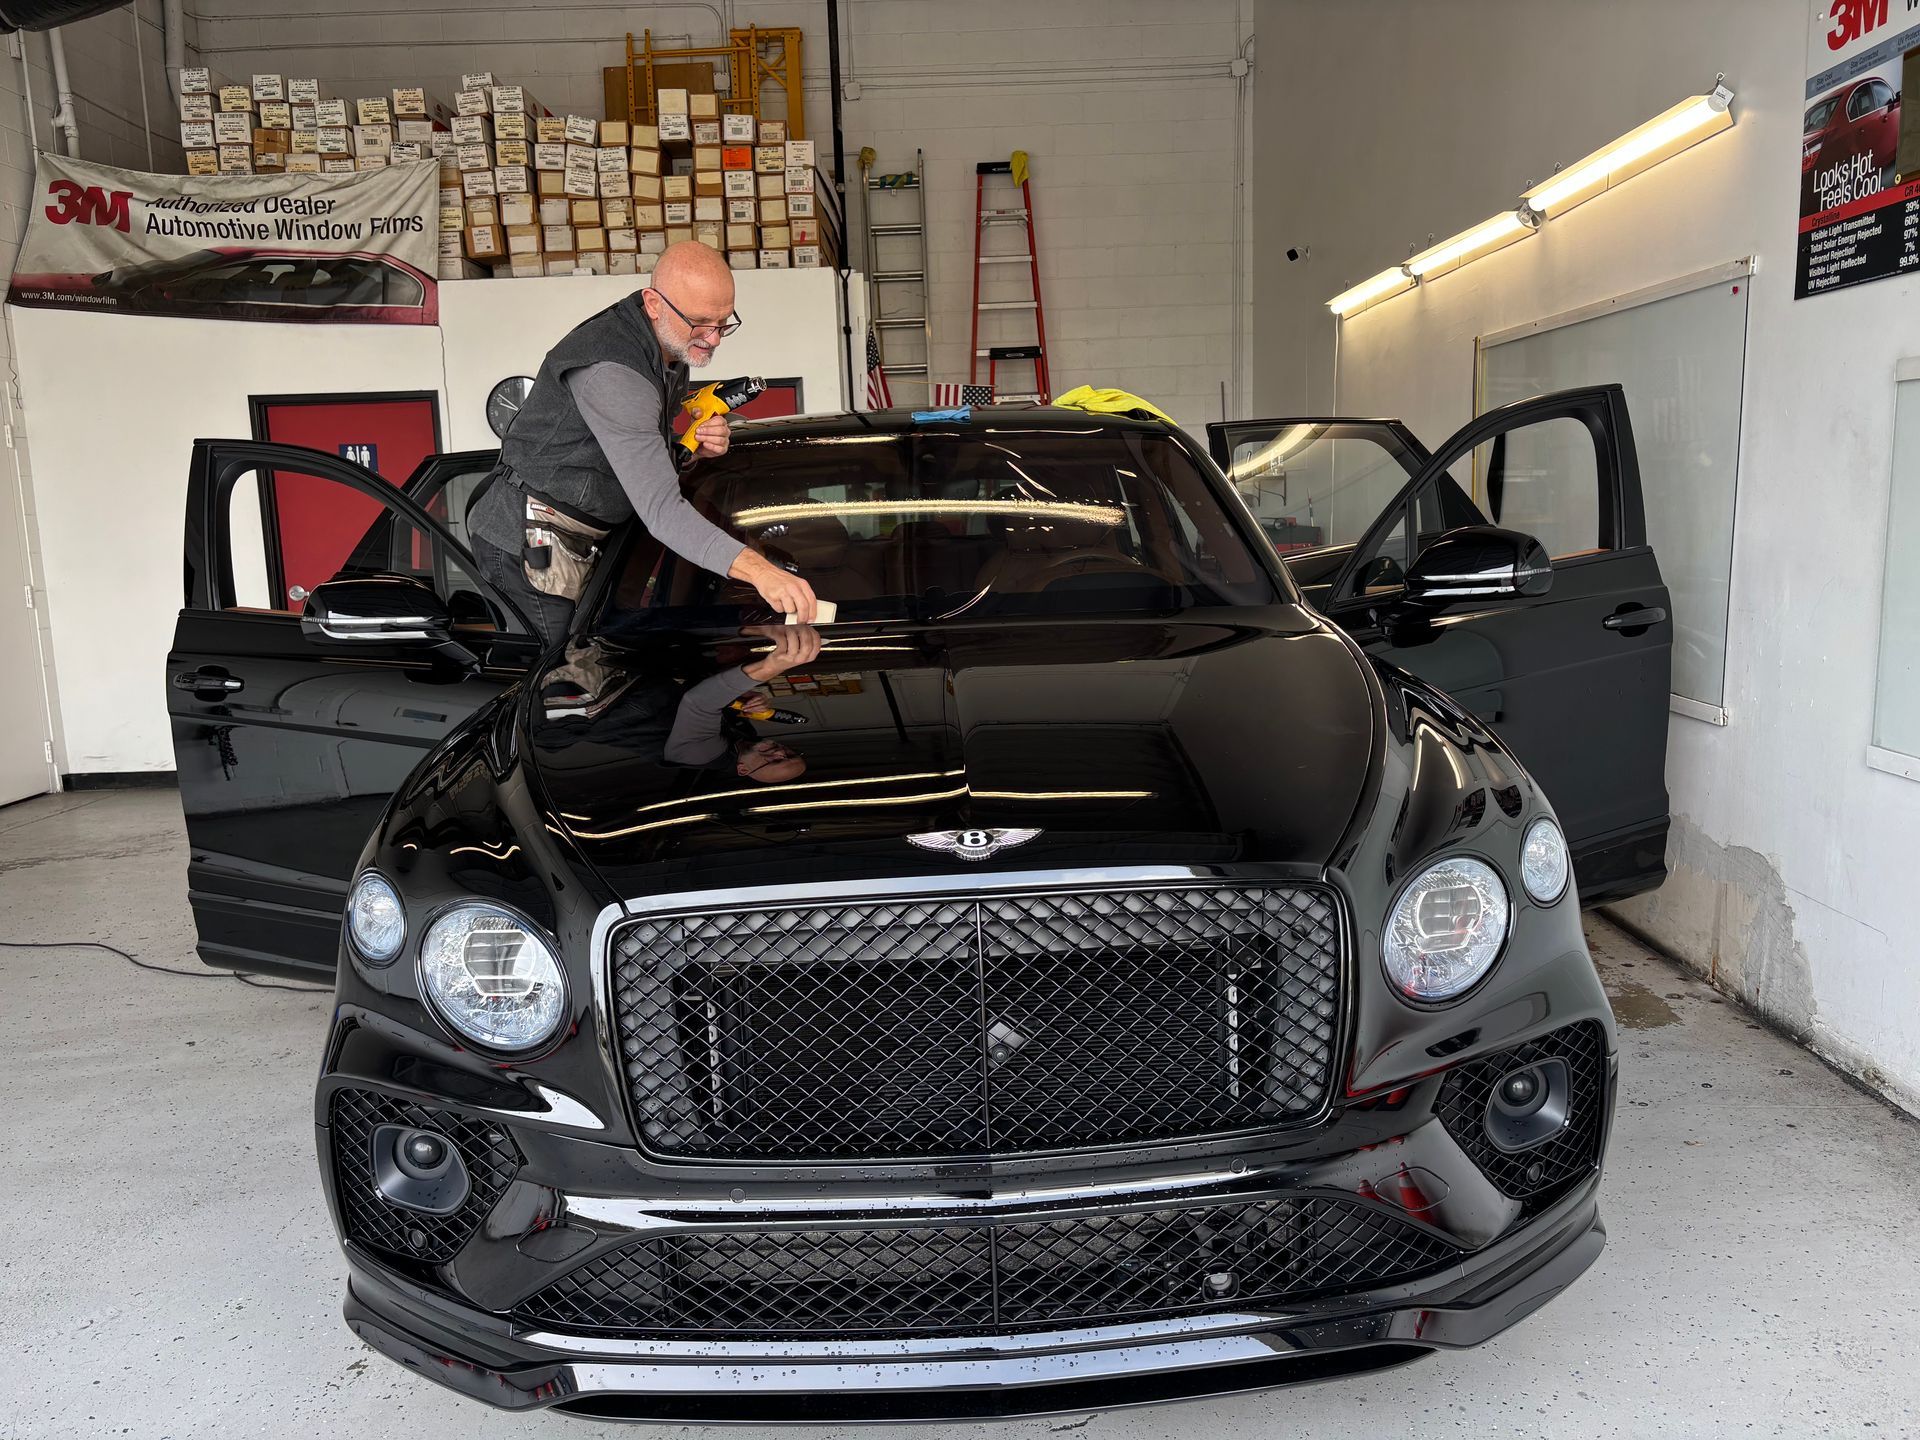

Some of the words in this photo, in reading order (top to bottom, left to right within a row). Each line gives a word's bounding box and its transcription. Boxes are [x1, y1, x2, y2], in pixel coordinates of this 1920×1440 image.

[1827, 0, 1888, 51] 3M
[1813, 161, 1850, 193] Looks
[1850, 149, 1876, 180] Hot.
[1820, 180, 1852, 212] Feels
[1853, 168, 1885, 200] Cool.
[45, 180, 133, 233] 3M
[145, 196, 259, 214] Authorized
[264, 196, 336, 216] Dealer
[1811, 230, 1828, 242] Visible
[1828, 224, 1843, 237] Light
[1843, 213, 1876, 231] Transmitted
[1905, 199, 1920, 213] 39%
[145, 213, 270, 240] Automotive
[275, 219, 362, 241] Window
[370, 215, 424, 236] Films
[1809, 253, 1830, 266] Infrared
[1903, 226, 1918, 240] 97%
[1810, 241, 1823, 254] Total
[1823, 238, 1837, 251] Solar
[1837, 233, 1857, 247] Energy
[1857, 224, 1882, 241] Rejected
[1904, 213, 1919, 227] 60%
[1807, 279, 1816, 290] UV
[1816, 275, 1840, 289] Rejection
[1899, 253, 1920, 268] 99.9%
[1808, 264, 1826, 278] Visible
[1826, 261, 1840, 275] Light
[1840, 254, 1867, 270] Reflected
[1904, 241, 1916, 253] 7%
[21, 291, 118, 305] www.3M.com/windowfilm
[963, 831, 988, 847] B
